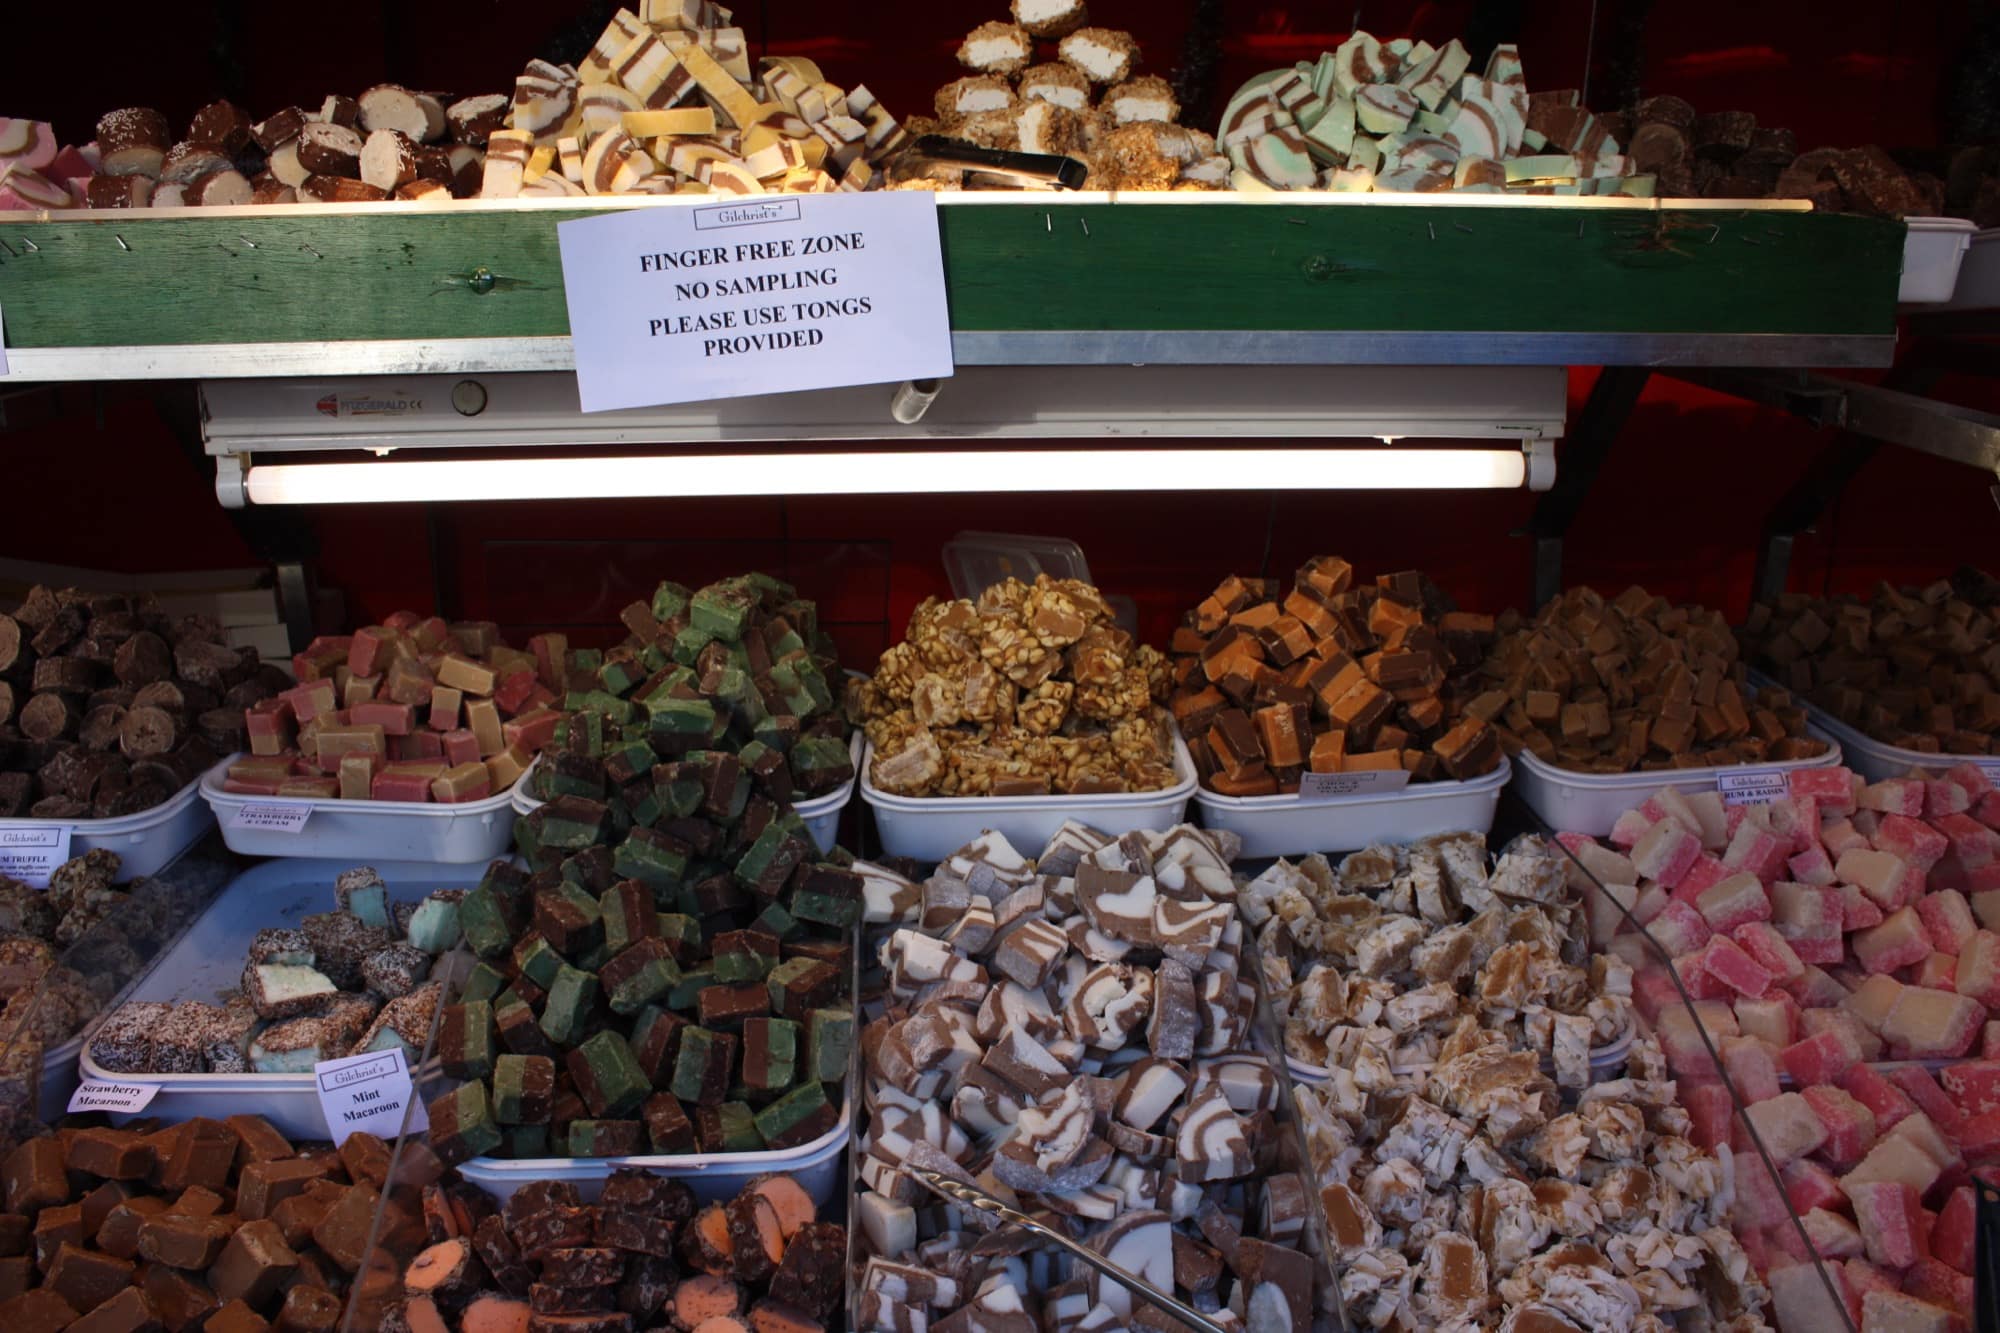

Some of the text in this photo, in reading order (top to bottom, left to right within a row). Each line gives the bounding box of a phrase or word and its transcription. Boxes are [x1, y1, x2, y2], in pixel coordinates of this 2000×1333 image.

[640, 231, 866, 273] FINGER FREE ZONE
[674, 267, 839, 302] NO SAMPLING
[649, 296, 873, 337] PLEASE USE TONGS
[703, 327, 825, 357] PROVIDED
[1724, 788, 1785, 800] RUM & RAISIN
[12, 855, 48, 863] TRUFFLE
[335, 1064, 385, 1084] Gilchrist's
[80, 1084, 141, 1096] Strawberry
[352, 1089, 381, 1105] Mint
[343, 1101, 400, 1122] Macaroon
